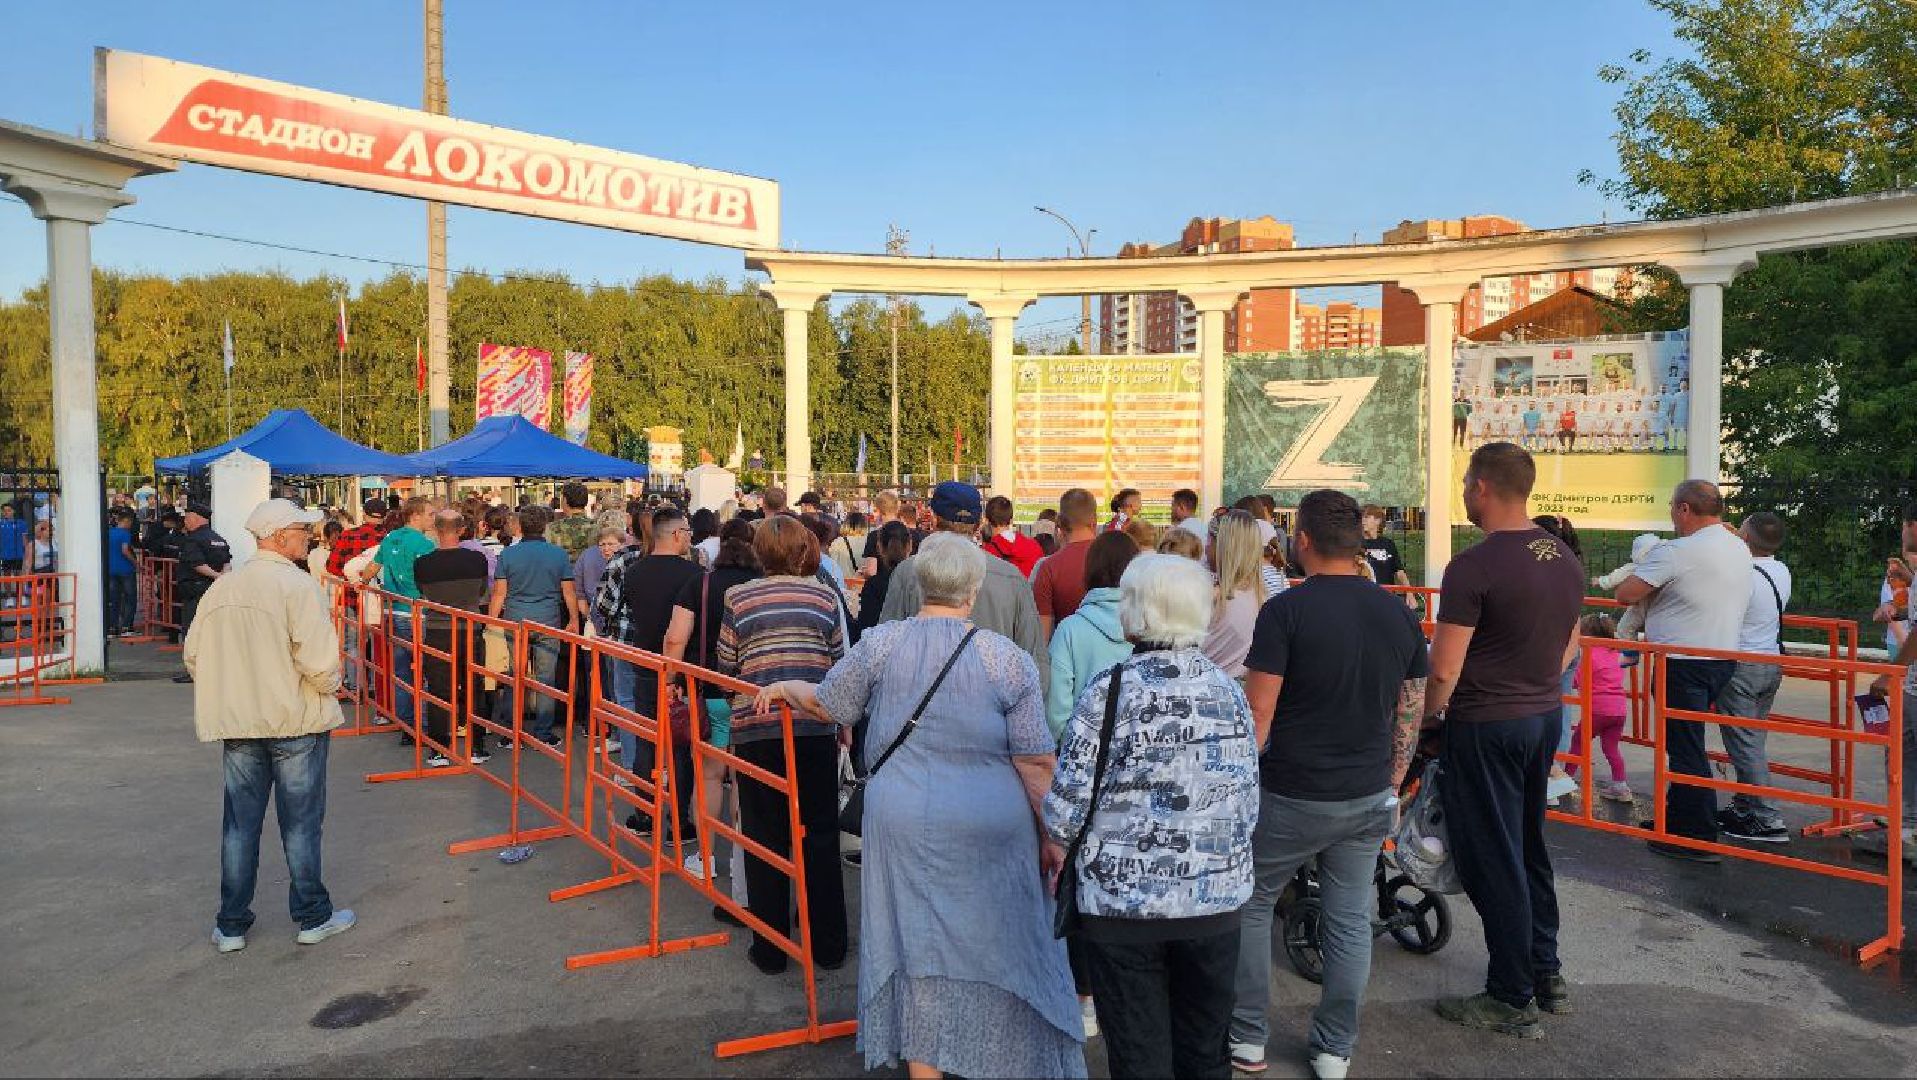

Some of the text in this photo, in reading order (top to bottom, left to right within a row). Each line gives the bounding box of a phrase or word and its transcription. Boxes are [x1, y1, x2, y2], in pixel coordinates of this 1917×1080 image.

[187, 103, 747, 226] СТАДИОН ЛОКОМОТИВ
[1262, 376, 1381, 490] Z
[1531, 493, 1656, 504] ФК Дмитров ДЗРТИ
[1536, 503, 1589, 514] 2023 год
